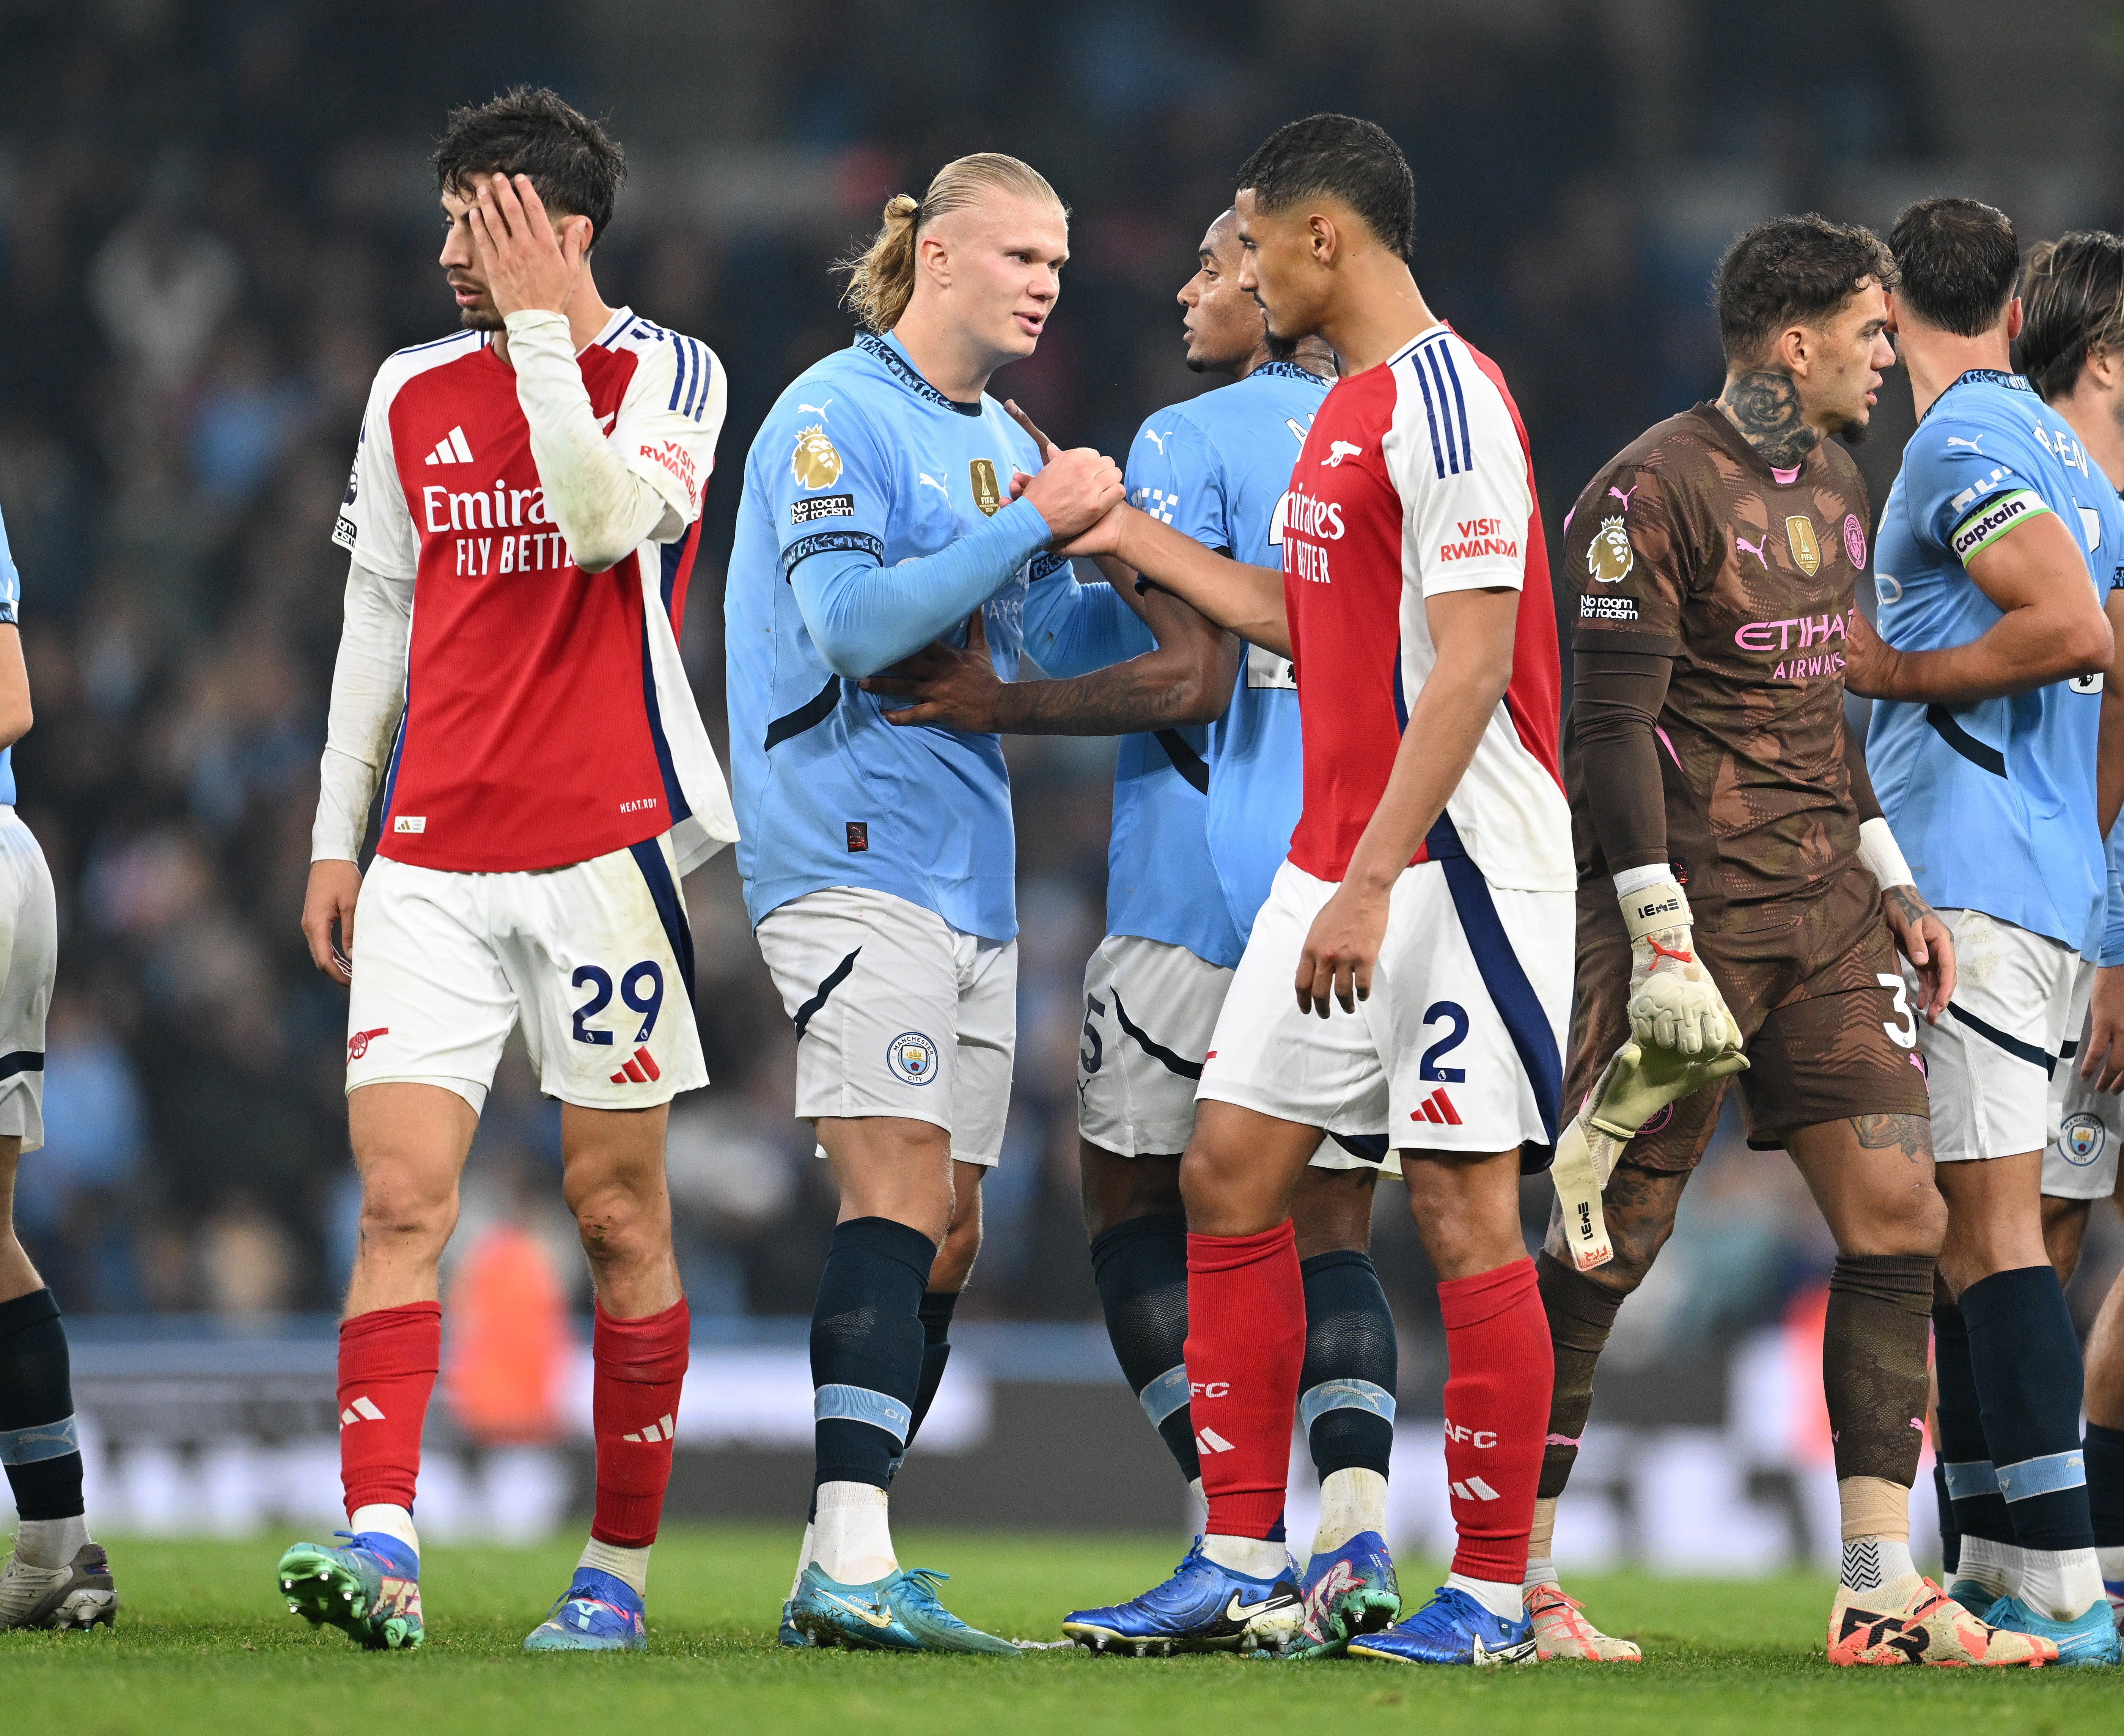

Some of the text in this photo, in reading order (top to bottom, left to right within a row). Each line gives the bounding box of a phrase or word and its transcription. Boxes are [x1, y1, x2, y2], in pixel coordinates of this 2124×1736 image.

[663, 440, 696, 476] VISIT
[640, 445, 696, 508] RWANDA
[423, 479, 556, 533] Emira
[791, 497, 847, 514] No room
[792, 507, 854, 524] for racism
[1283, 482, 1345, 540] mirates
[1457, 519, 1501, 538] VISIT
[1956, 501, 2027, 552] Captain
[456, 532, 578, 576] FLY BETT
[1283, 536, 1293, 574] LY
[1440, 538, 1517, 562] RWANDA
[1581, 595, 1633, 609] No room
[1581, 606, 1638, 620] for racism
[1773, 651, 1846, 679] AIRWAYS
[620, 797, 657, 813] HEAT.RDY
[572, 960, 664, 1046] 29
[1877, 973, 1916, 1049] 3
[893, 1036, 934, 1055] MANCHESTER
[1419, 1000, 1470, 1083] 2
[1187, 1382, 1229, 1398] FC
[1445, 1418, 1497, 1448] AFC
